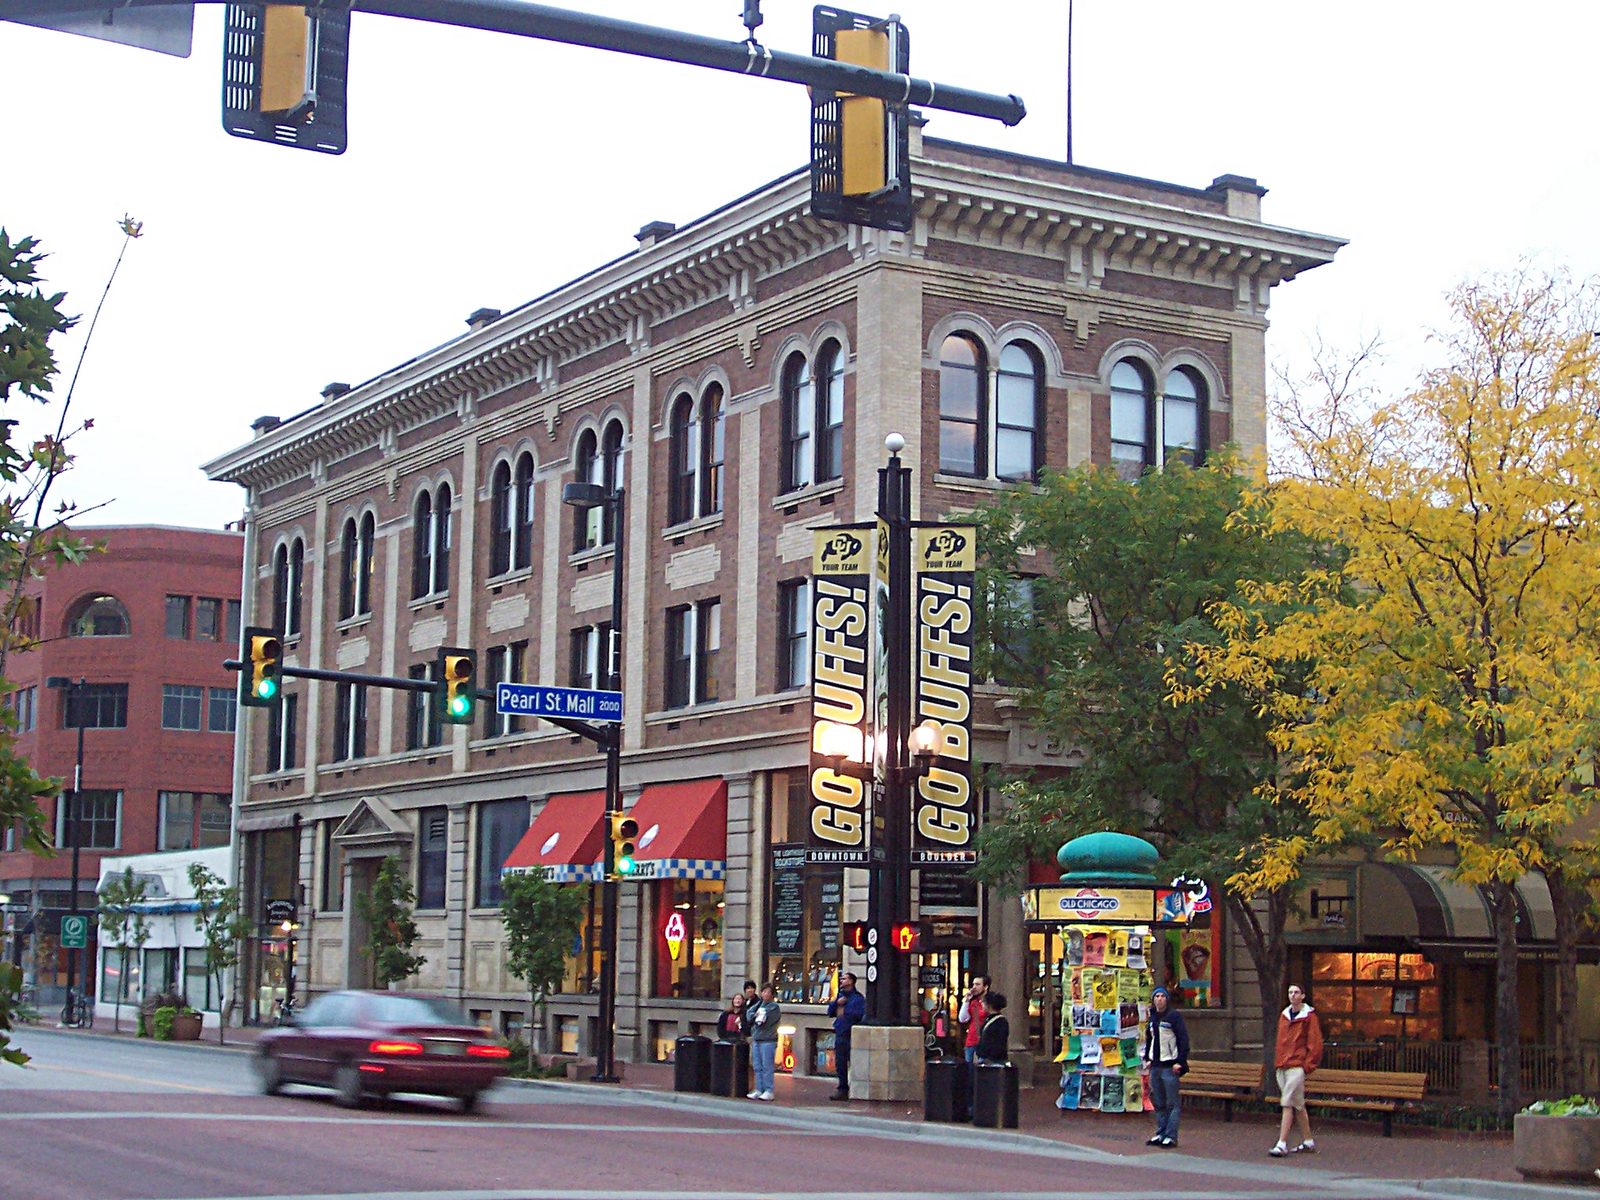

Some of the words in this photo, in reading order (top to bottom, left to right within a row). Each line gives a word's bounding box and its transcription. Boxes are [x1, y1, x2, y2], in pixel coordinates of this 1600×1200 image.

[822, 563, 840, 571] YOUR
[841, 563, 858, 571] TEAM
[945, 560, 962, 568] TEAM
[813, 580, 866, 763] BUFFS!
[919, 577, 971, 761] BUFFS!
[501, 689, 540, 709] Pearl
[545, 692, 561, 711] St
[566, 694, 594, 714] Mall
[600, 701, 620, 711] 2000
[812, 767, 863, 845] GO
[918, 767, 970, 845] GO
[811, 852, 863, 861] DOWNTOWN
[920, 852, 967, 861] BOULDER
[1061, 900, 1076, 908] OLD
[1077, 899, 1117, 909] CHICAGO
